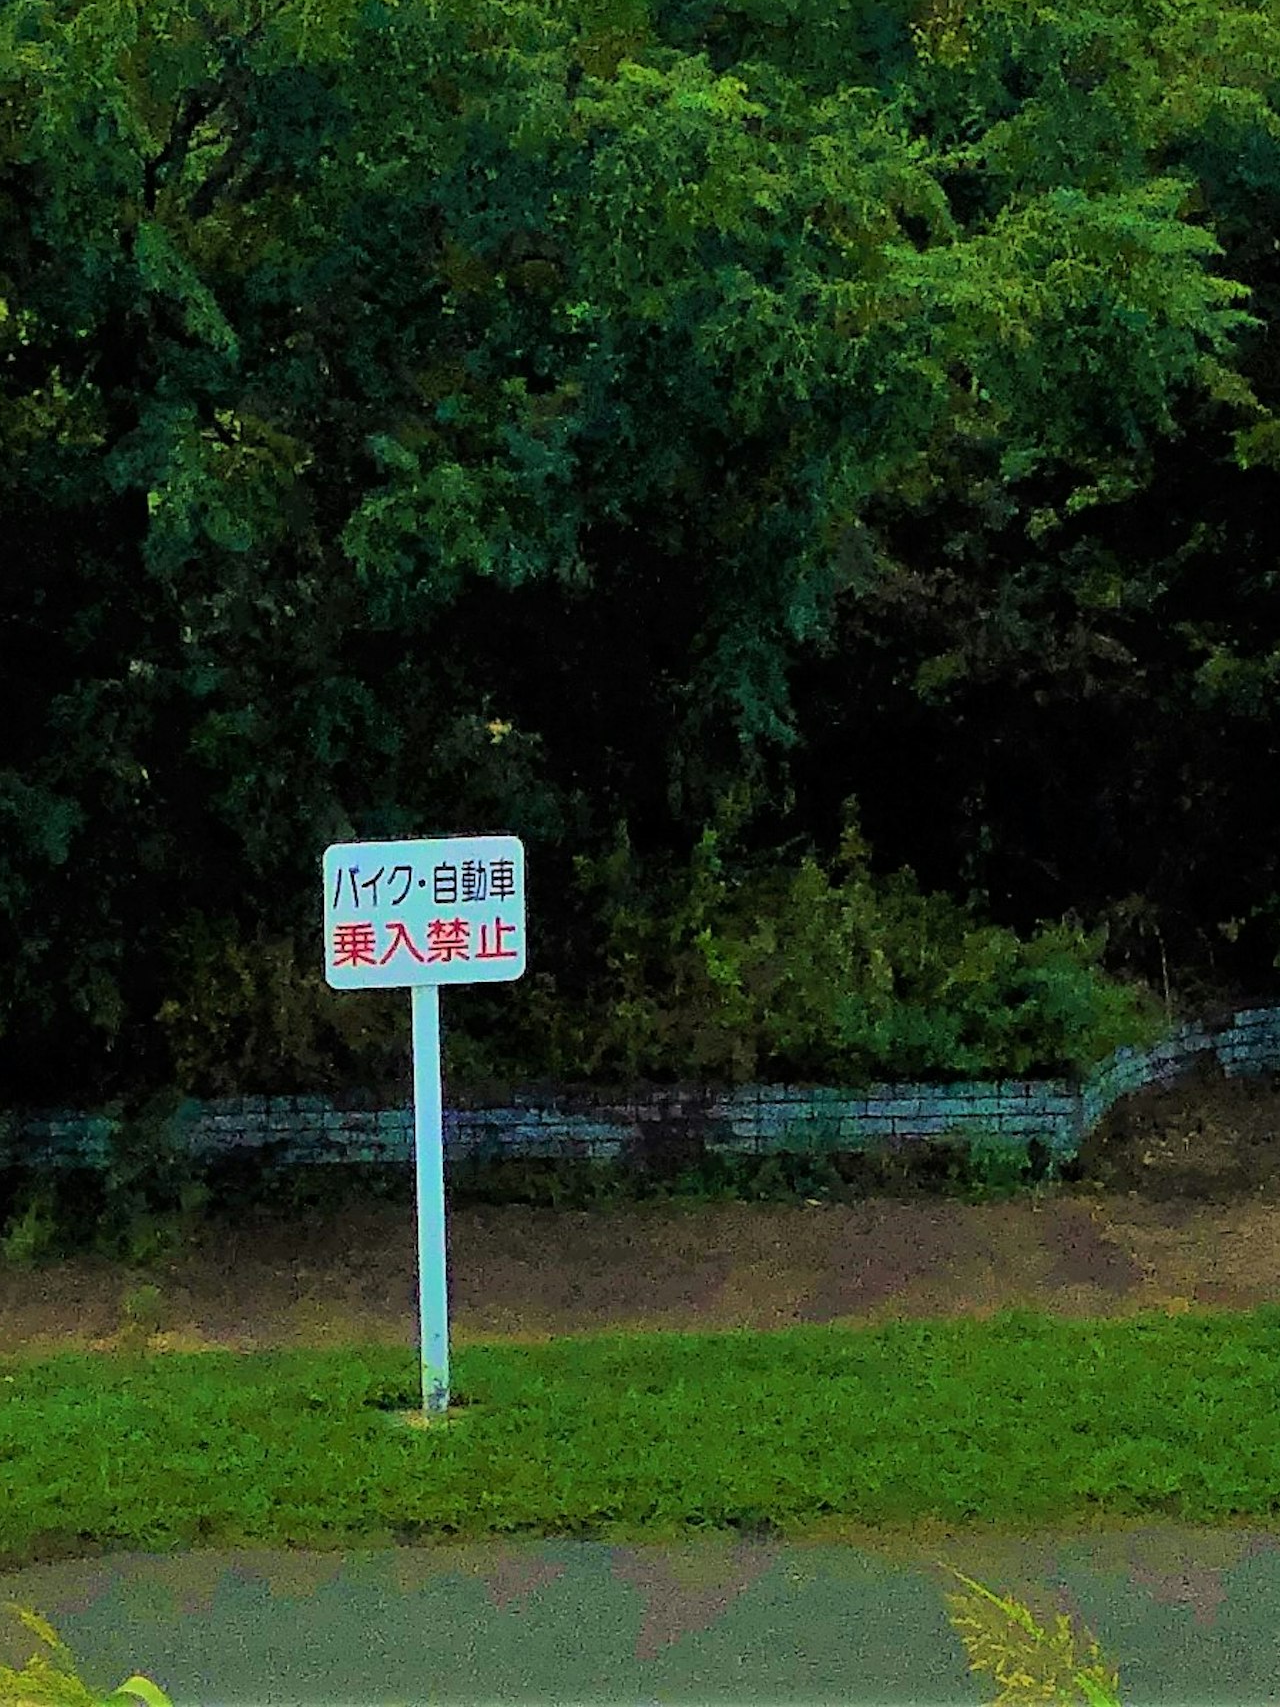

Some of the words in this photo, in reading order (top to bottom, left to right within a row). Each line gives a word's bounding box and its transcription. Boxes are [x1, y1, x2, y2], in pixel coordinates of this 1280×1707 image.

[333, 857, 515, 909] バイク・自動車
[332, 916, 518, 967] 乗入禁止
